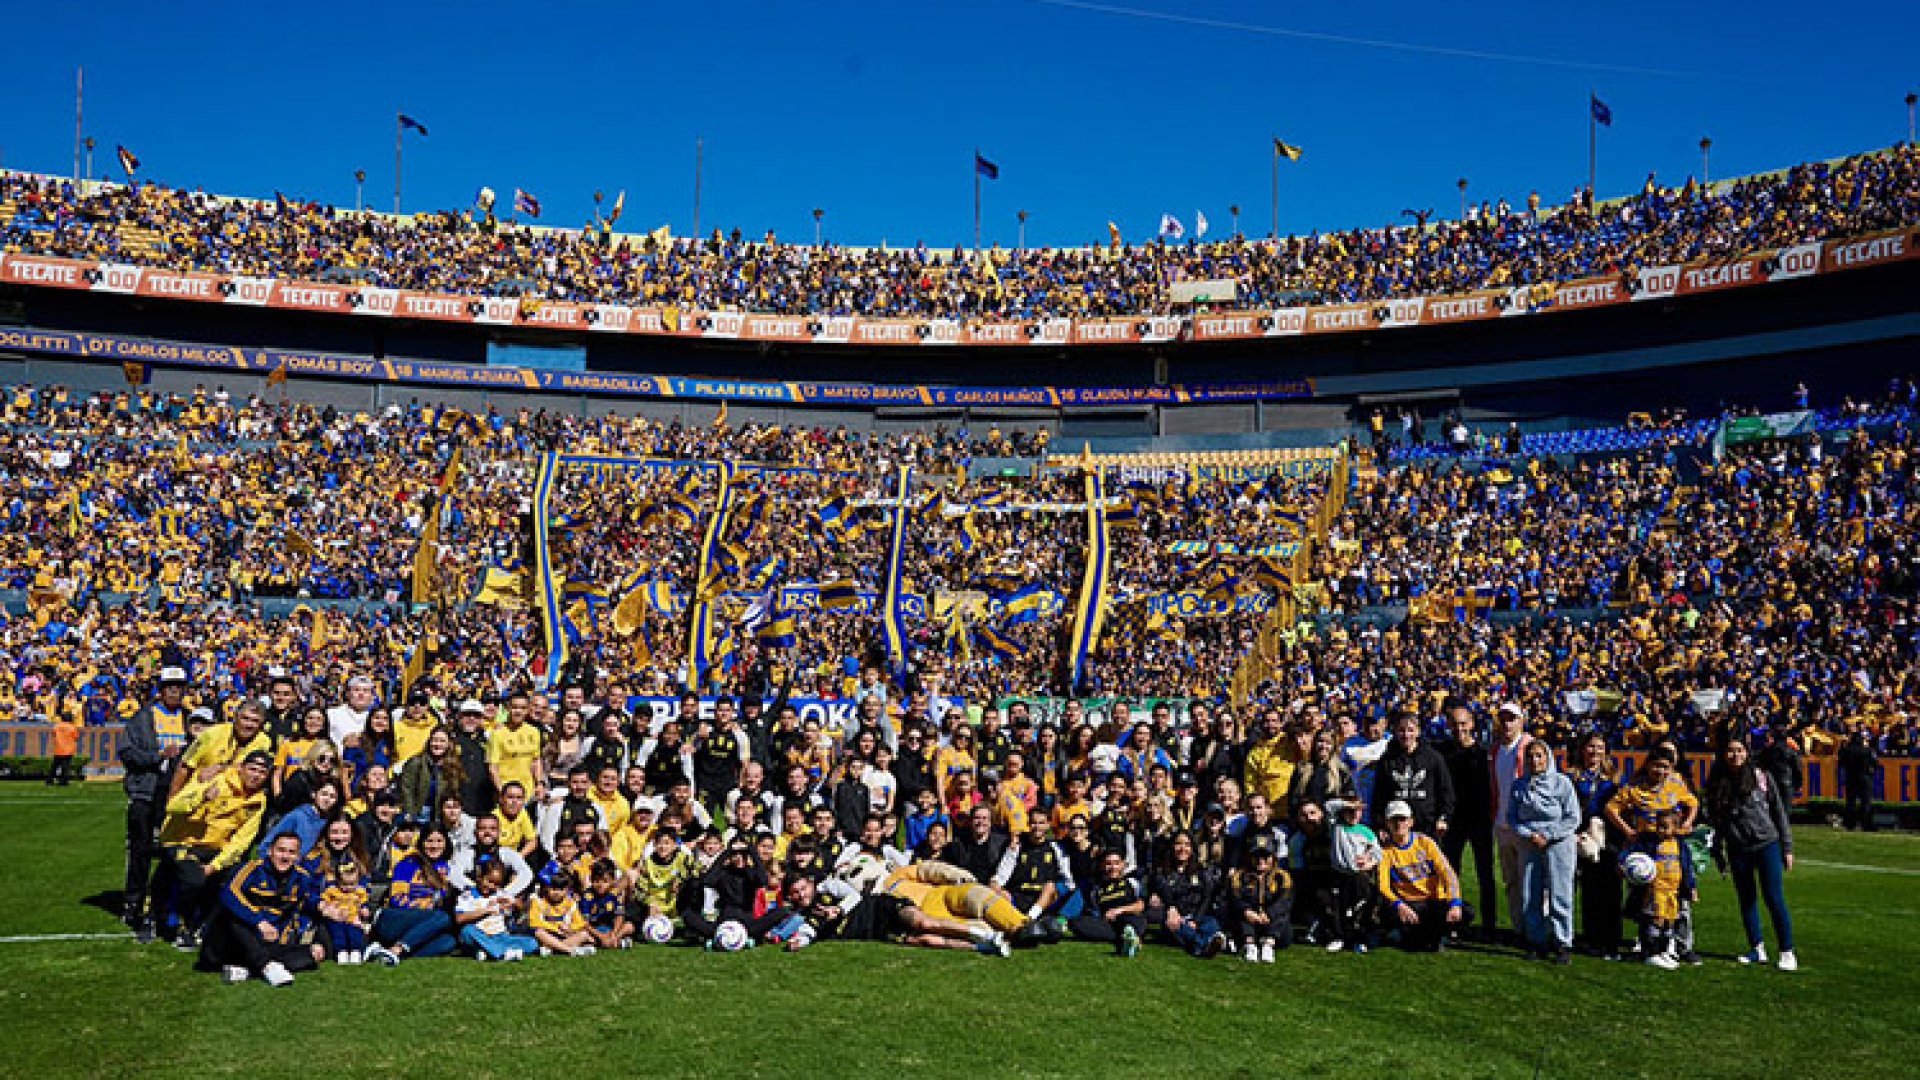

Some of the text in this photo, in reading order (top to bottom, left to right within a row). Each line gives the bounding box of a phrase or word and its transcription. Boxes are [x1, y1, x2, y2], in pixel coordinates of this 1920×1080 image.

[1832, 235, 1905, 265] TECATE
[10, 260, 77, 284] TECATE
[1685, 261, 1753, 288] TECATE
[148, 274, 211, 297] TECATE
[1555, 281, 1617, 306] TECATE
[280, 287, 341, 307] TECATE
[405, 297, 462, 316] TECATE
[527, 304, 578, 325] CATE
[1429, 297, 1487, 319] TECATE
[1199, 317, 1252, 335] TECATE
[1313, 310, 1367, 328] TECATE
[749, 320, 801, 337] TECATE
[858, 323, 910, 340] TECATE
[1078, 321, 1130, 340] TECATE
[117, 342, 179, 359] CARLOS
[341, 360, 374, 373] BOY
[544, 373, 652, 391] 7 BARBADILLO
[695, 382, 735, 395] PILAR
[739, 384, 783, 398] REYES
[824, 386, 870, 399] MATEO
[873, 386, 917, 400] BRAVO
[955, 391, 1000, 403] CARLOS
